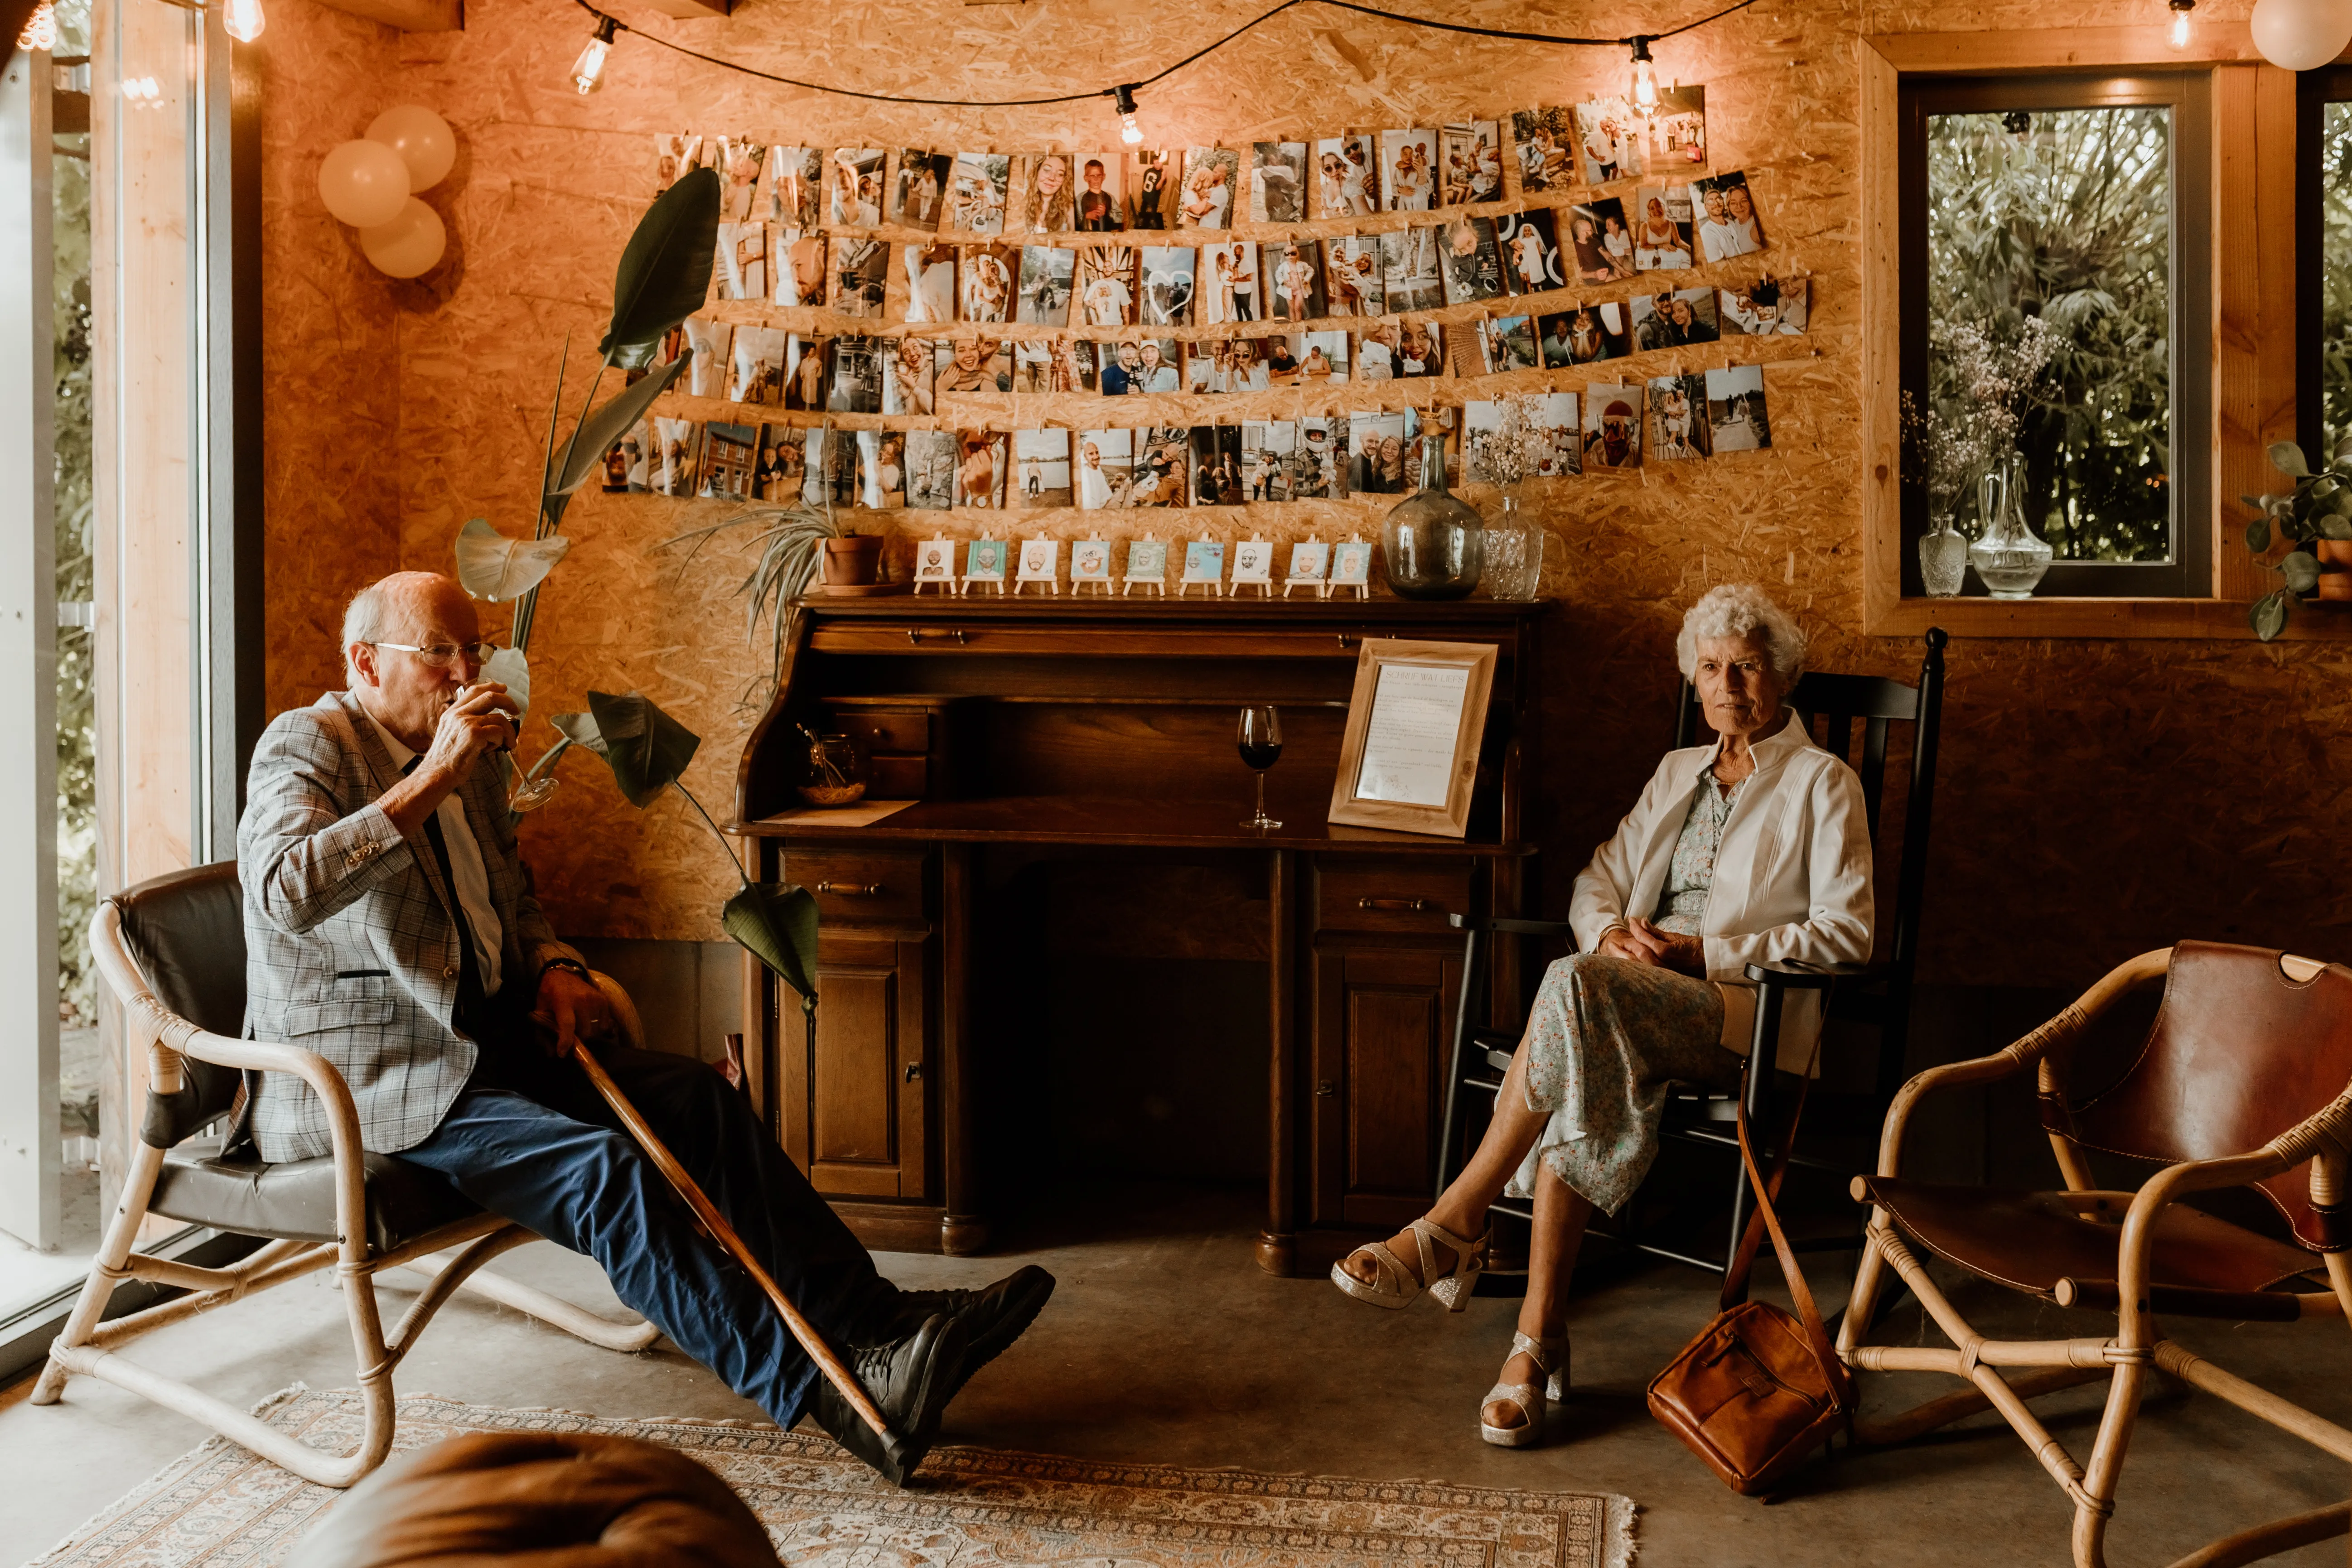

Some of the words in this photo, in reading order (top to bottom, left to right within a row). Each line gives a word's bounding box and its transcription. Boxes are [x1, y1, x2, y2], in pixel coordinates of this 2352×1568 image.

[1143, 172, 1157, 193] 6
[1420, 673, 1440, 681] WAT
[1440, 675, 1464, 683] LIEFS
